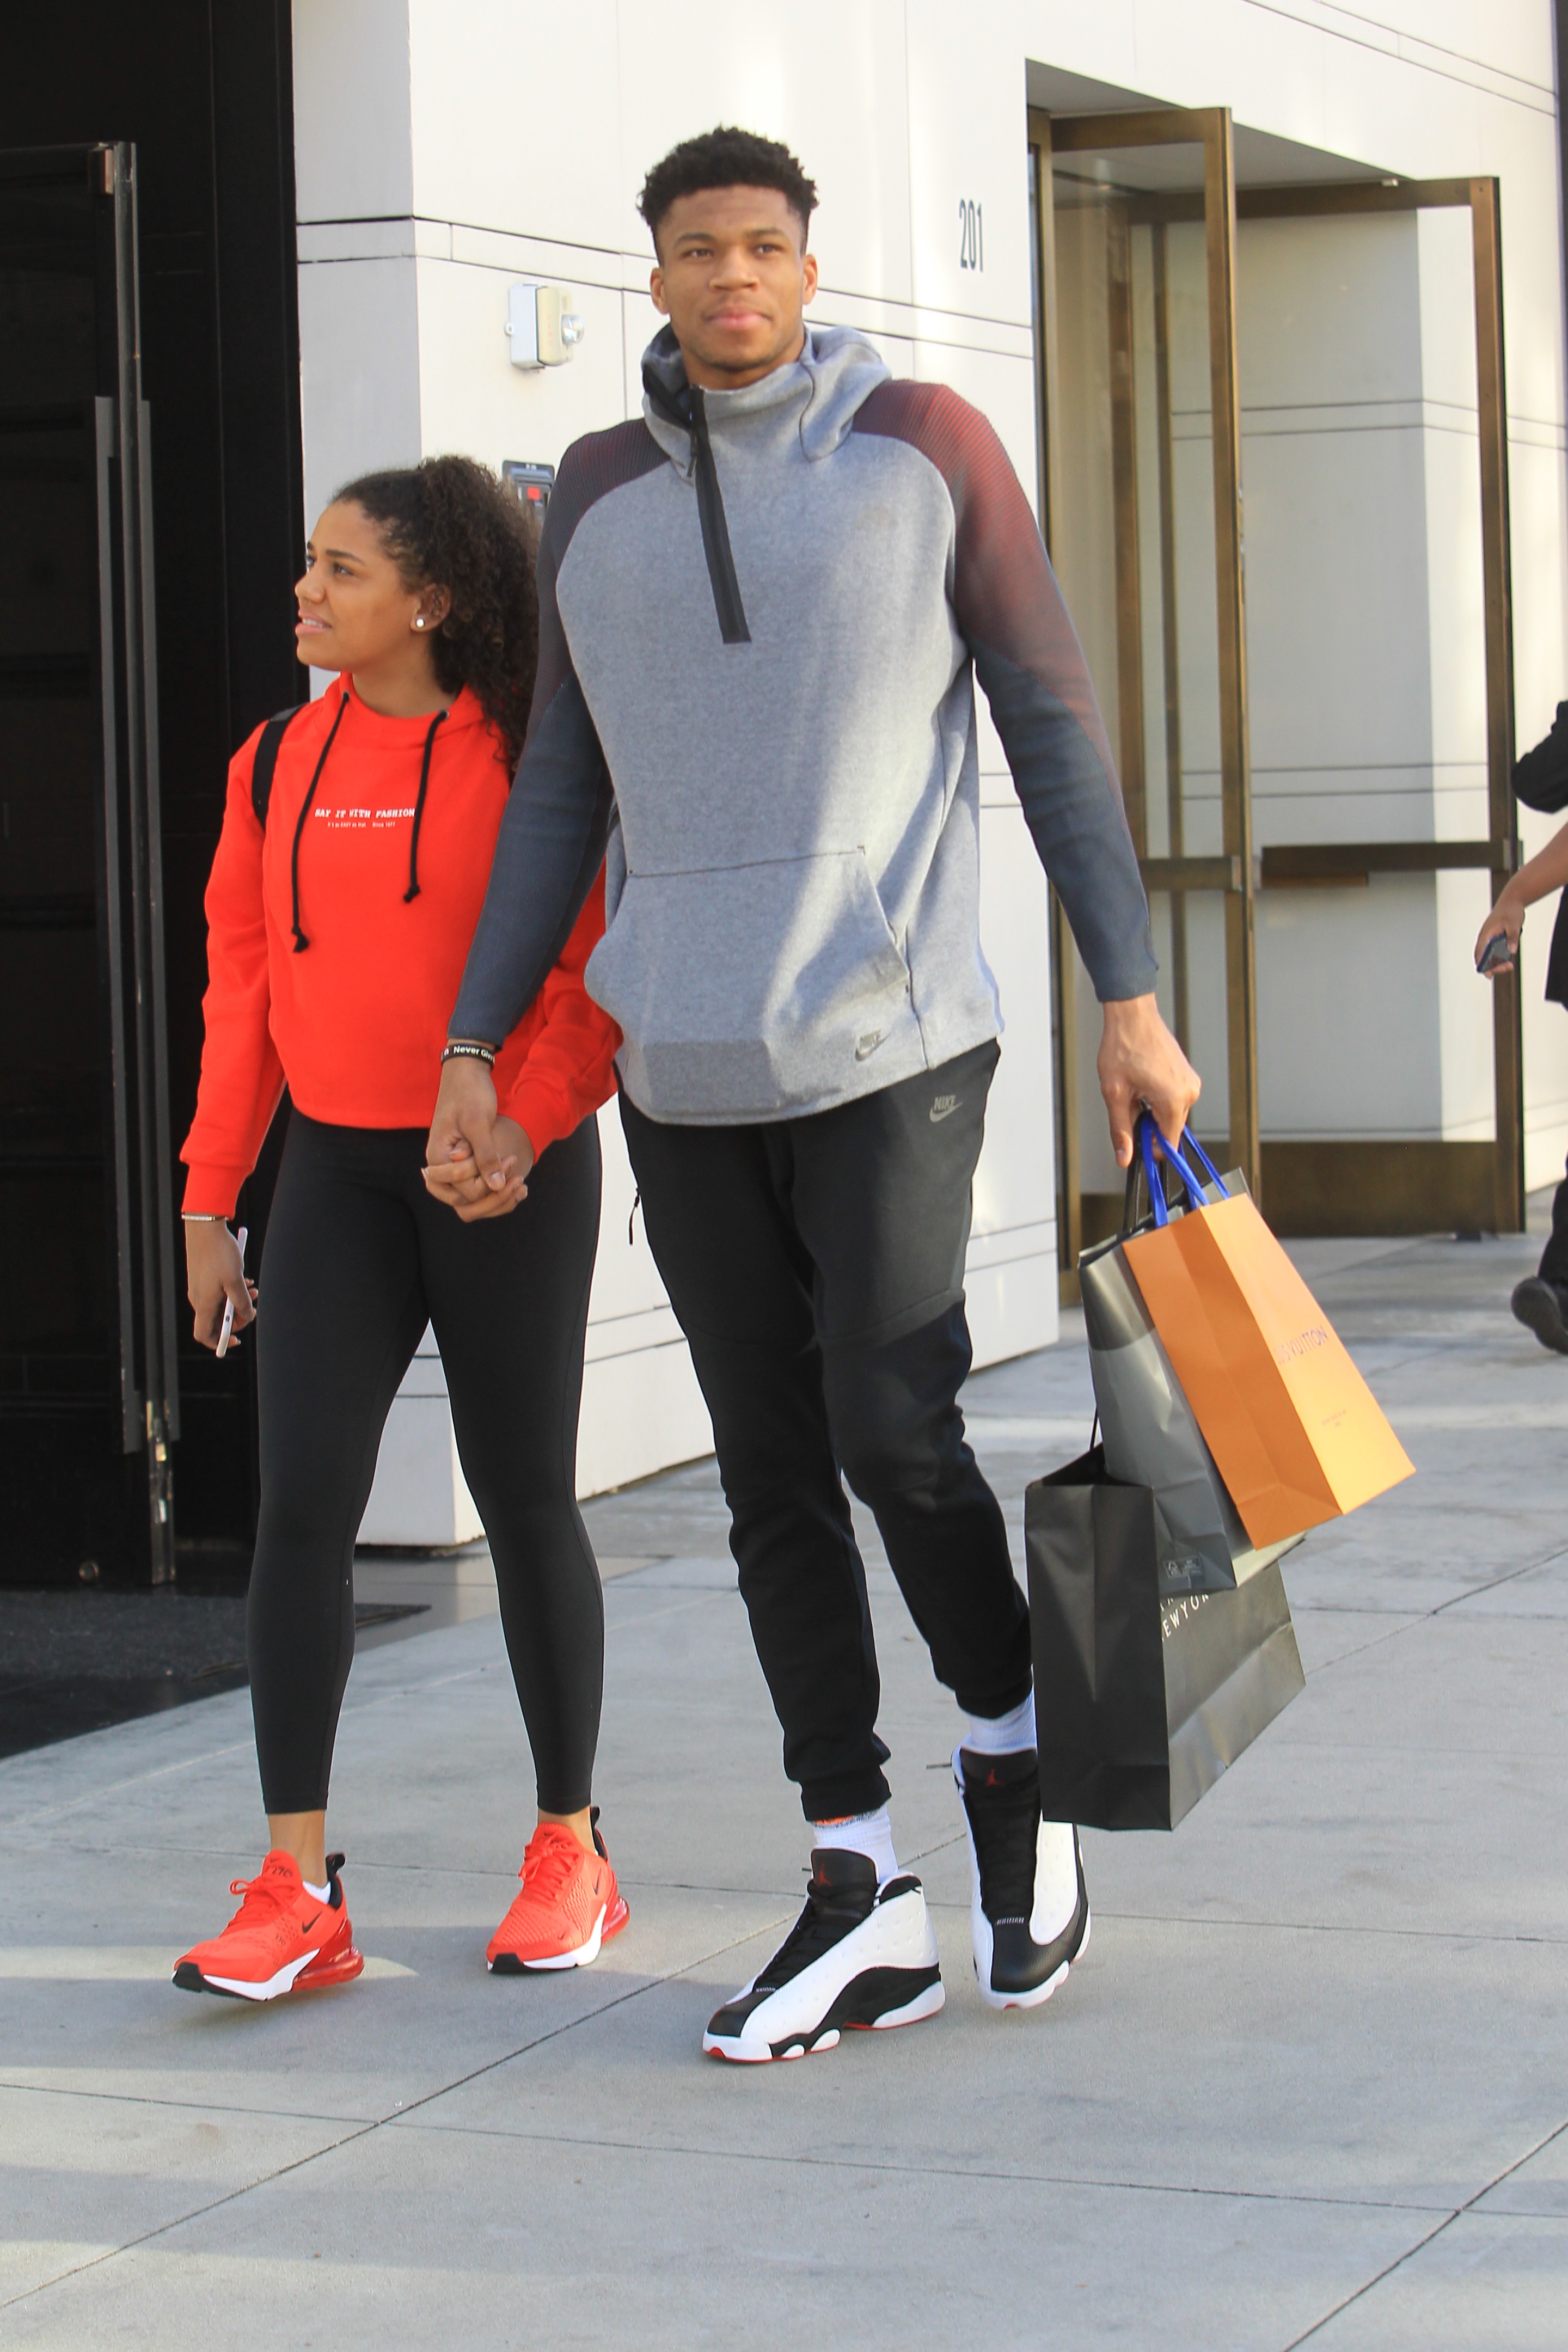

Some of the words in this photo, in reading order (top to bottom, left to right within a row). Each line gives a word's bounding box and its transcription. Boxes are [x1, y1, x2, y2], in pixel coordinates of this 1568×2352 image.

[959, 198, 983, 273] 201
[335, 810, 346, 818] IT
[349, 808, 371, 818] WITH
[454, 1045, 480, 1055] Never
[934, 1094, 956, 1110] NIKE
